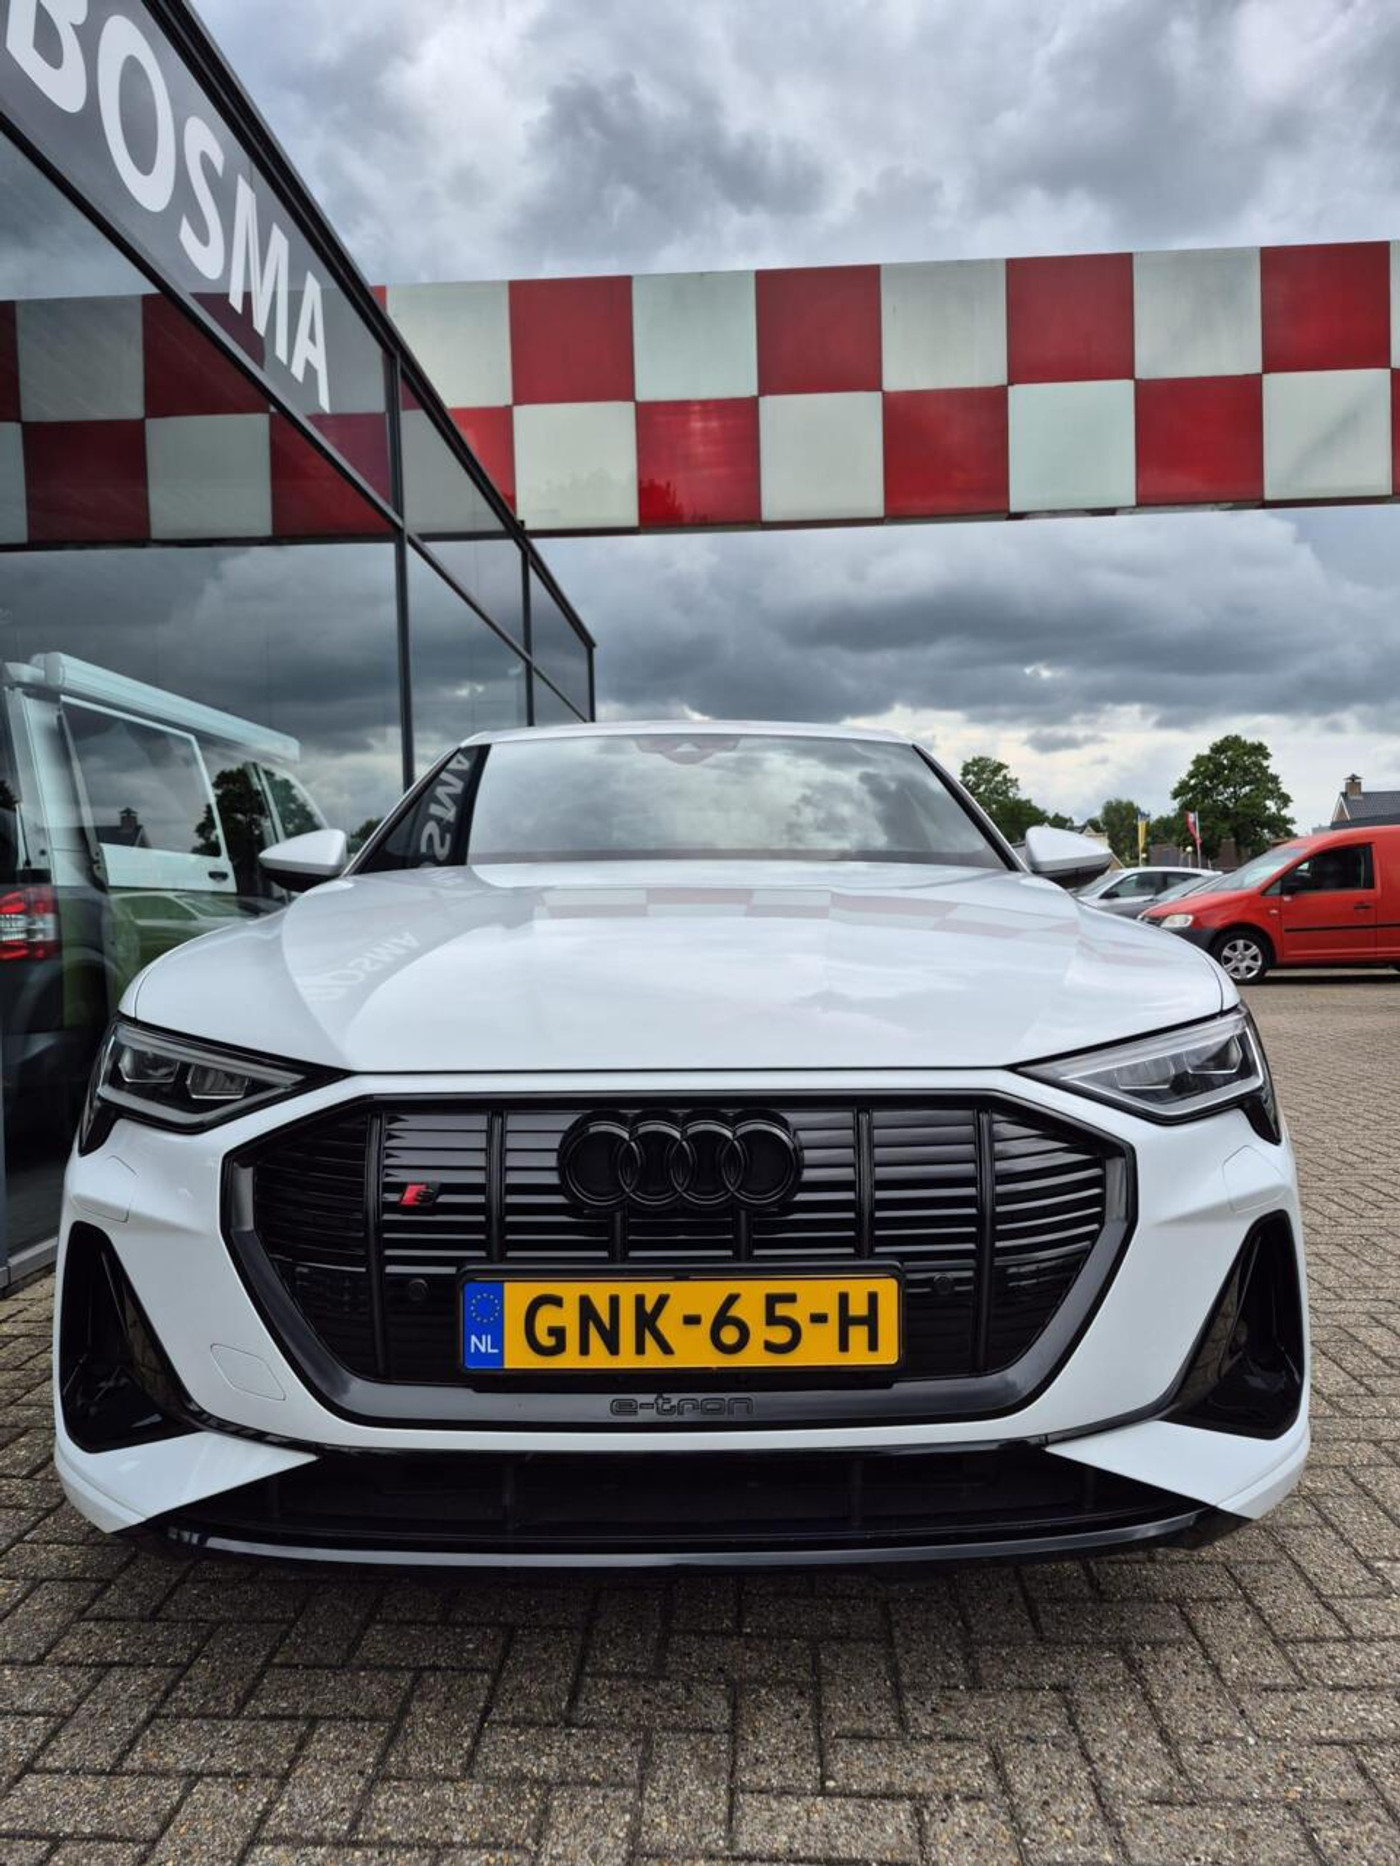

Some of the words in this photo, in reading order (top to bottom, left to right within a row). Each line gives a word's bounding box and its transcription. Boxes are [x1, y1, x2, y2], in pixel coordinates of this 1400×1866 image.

[524, 1291, 879, 1357] GNK-65-H
[470, 1334, 499, 1354] NL
[609, 1393, 754, 1416] e-tron
